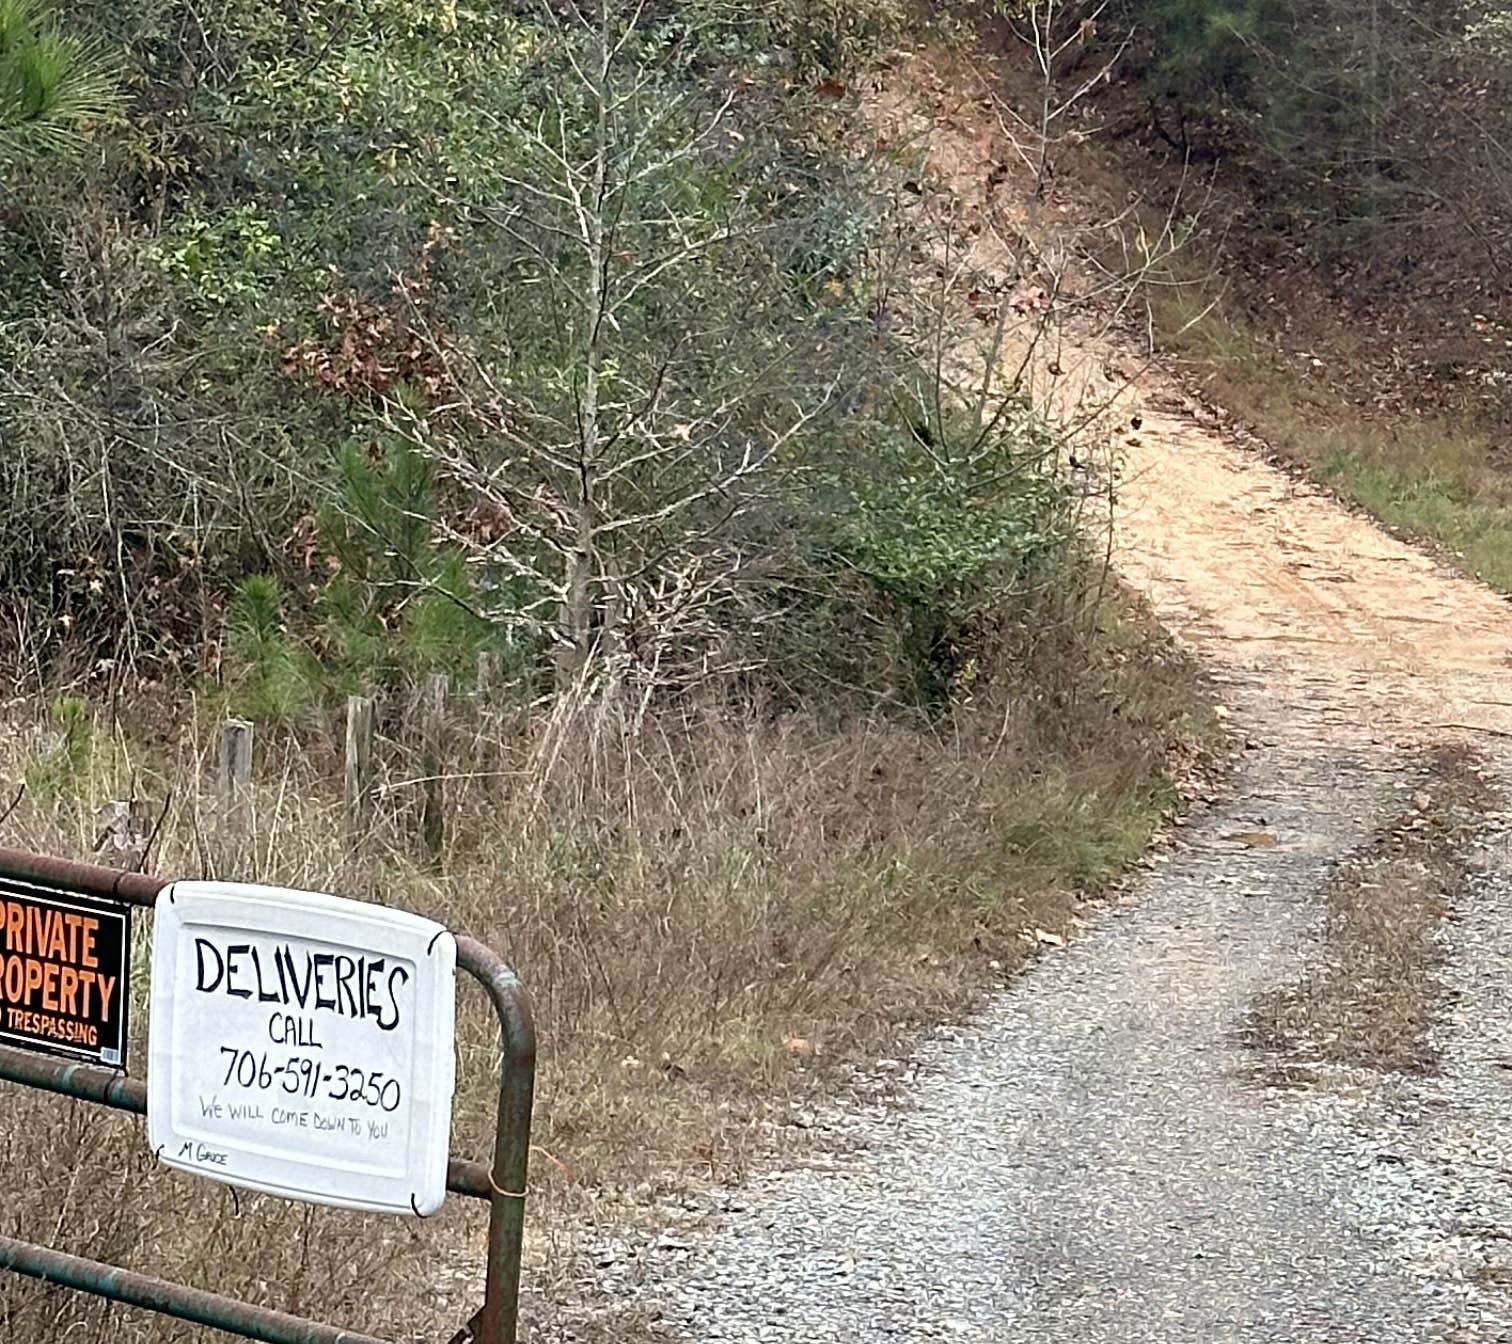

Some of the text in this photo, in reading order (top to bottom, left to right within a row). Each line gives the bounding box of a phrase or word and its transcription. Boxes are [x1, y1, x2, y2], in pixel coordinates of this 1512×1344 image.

[195, 938, 409, 1031] DELIVERIES
[7, 1007, 98, 1046] TRESPASSING
[269, 1012, 323, 1049] CALL
[220, 1046, 400, 1112] 706-591-3250
[229, 1103, 264, 1120] WILL
[271, 1107, 308, 1128] COME
[313, 1112, 345, 1131] DOWN
[348, 1117, 361, 1136] TO
[367, 1119, 389, 1140] YOU
[178, 1141, 193, 1161] M
